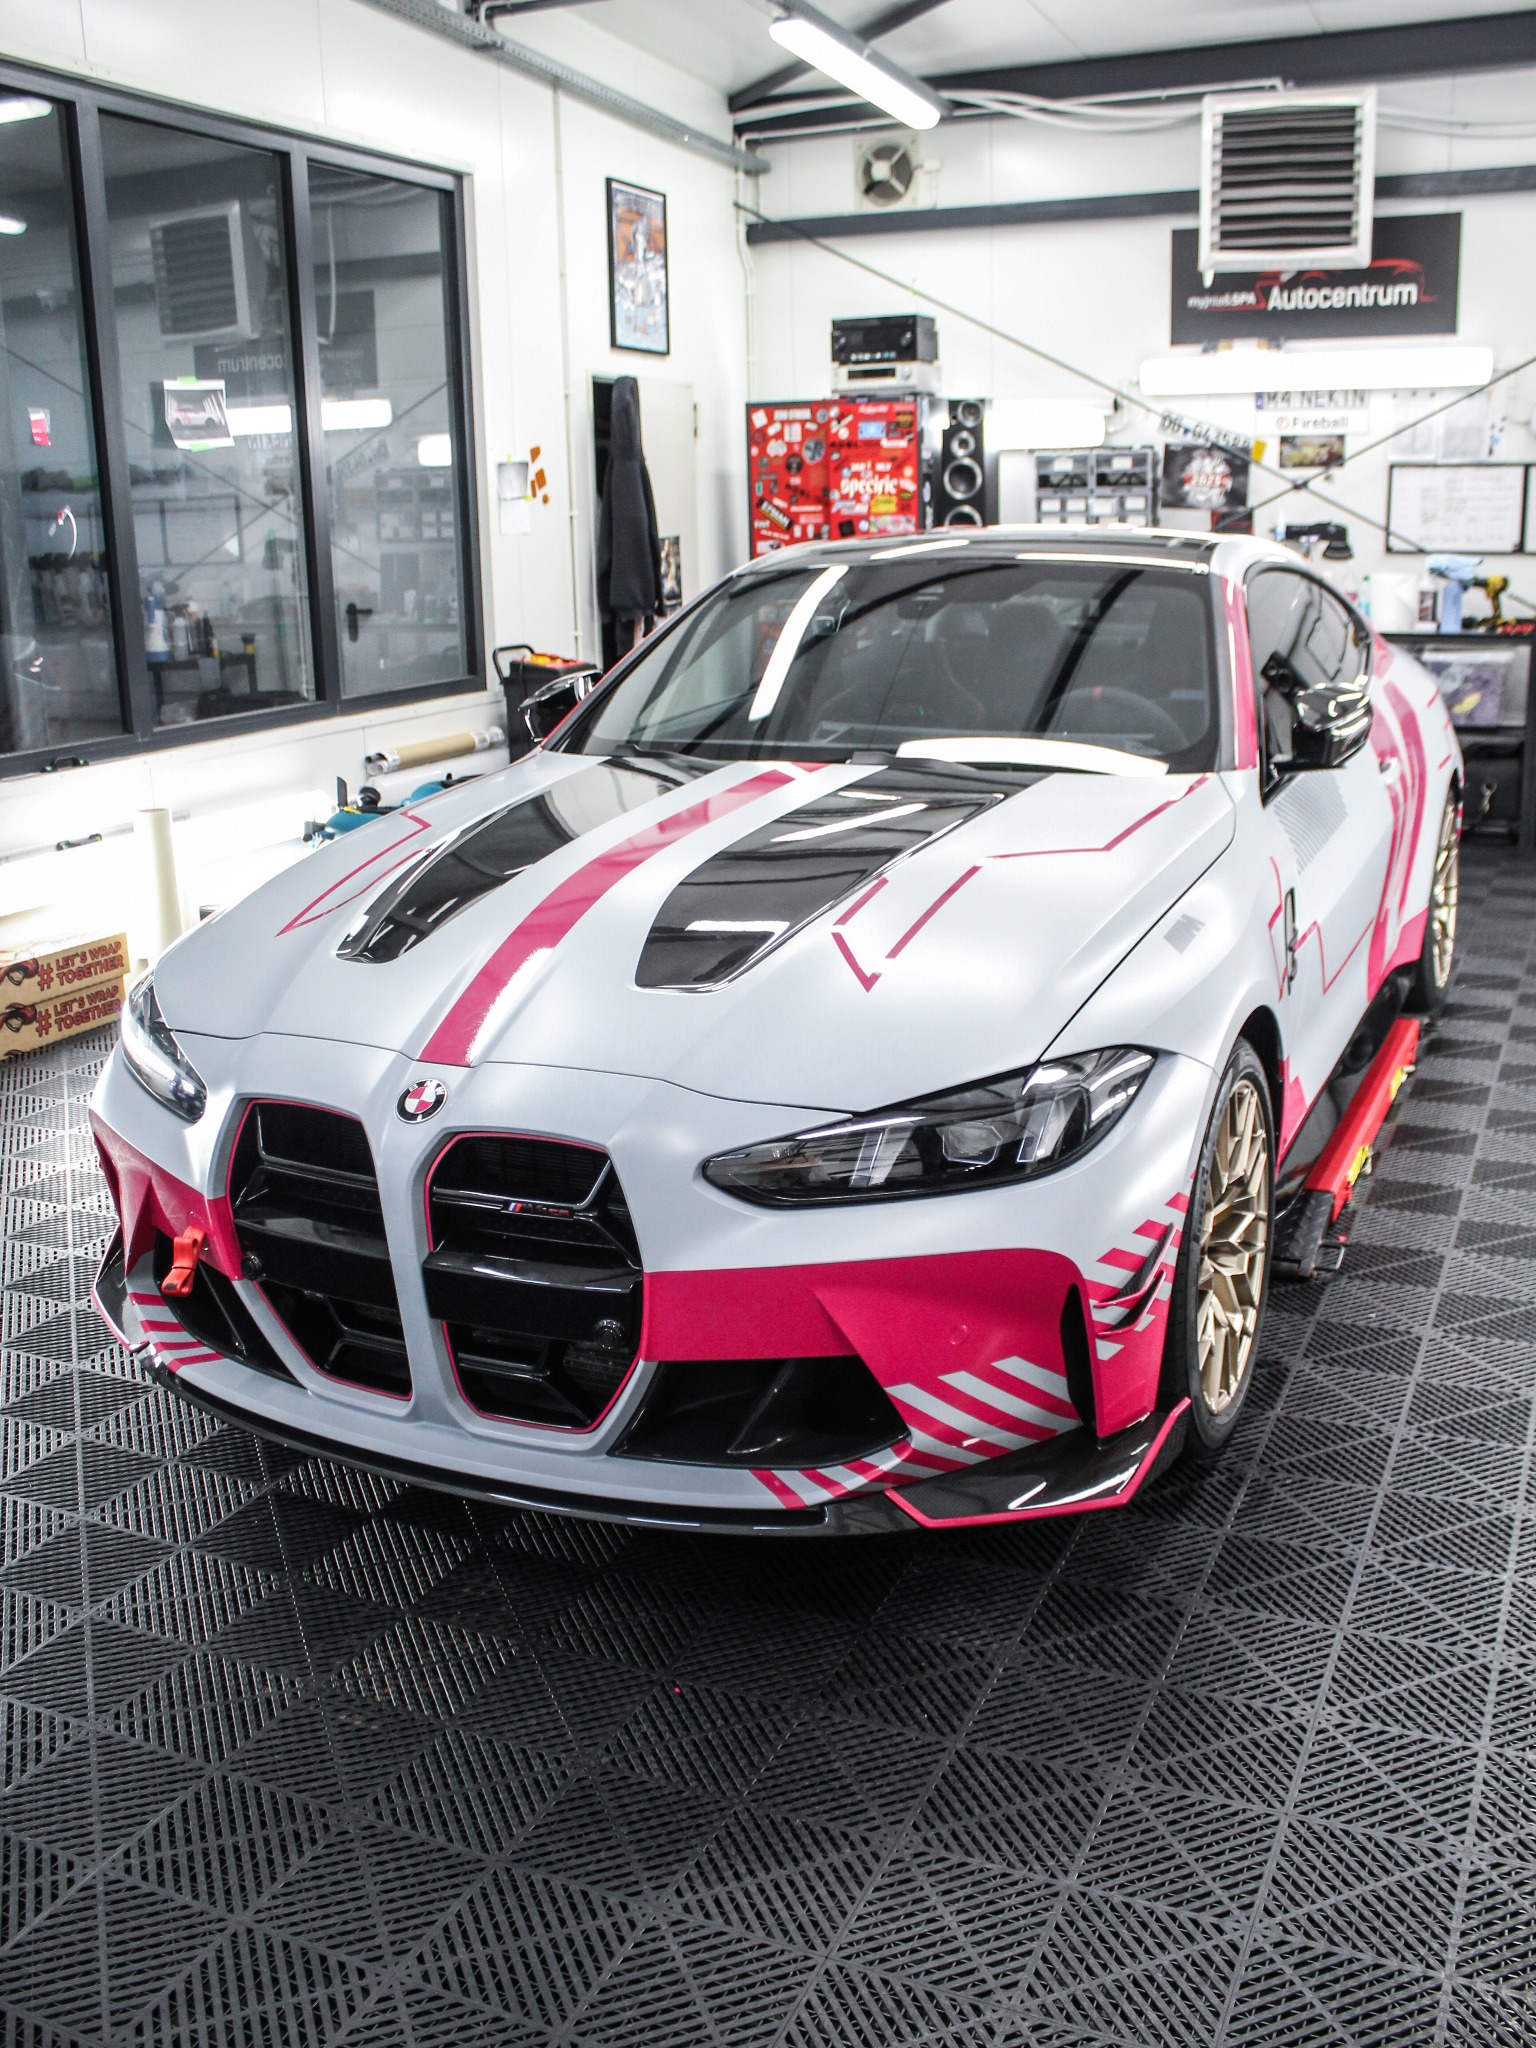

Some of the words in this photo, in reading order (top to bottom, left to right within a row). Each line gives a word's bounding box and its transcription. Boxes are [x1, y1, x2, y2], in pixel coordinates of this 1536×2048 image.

[1267, 281, 1419, 311] Autocentrum
[1292, 415, 1349, 430] Fireball
[56, 952, 86, 970] LET'S
[89, 942, 121, 957] WRAP
[57, 956, 124, 986] TOGETHER
[54, 997, 85, 1015] LET'S
[86, 985, 119, 1003] WRAP
[56, 1000, 121, 1031] TOGETHER
[408, 1079, 446, 1096] BMW
